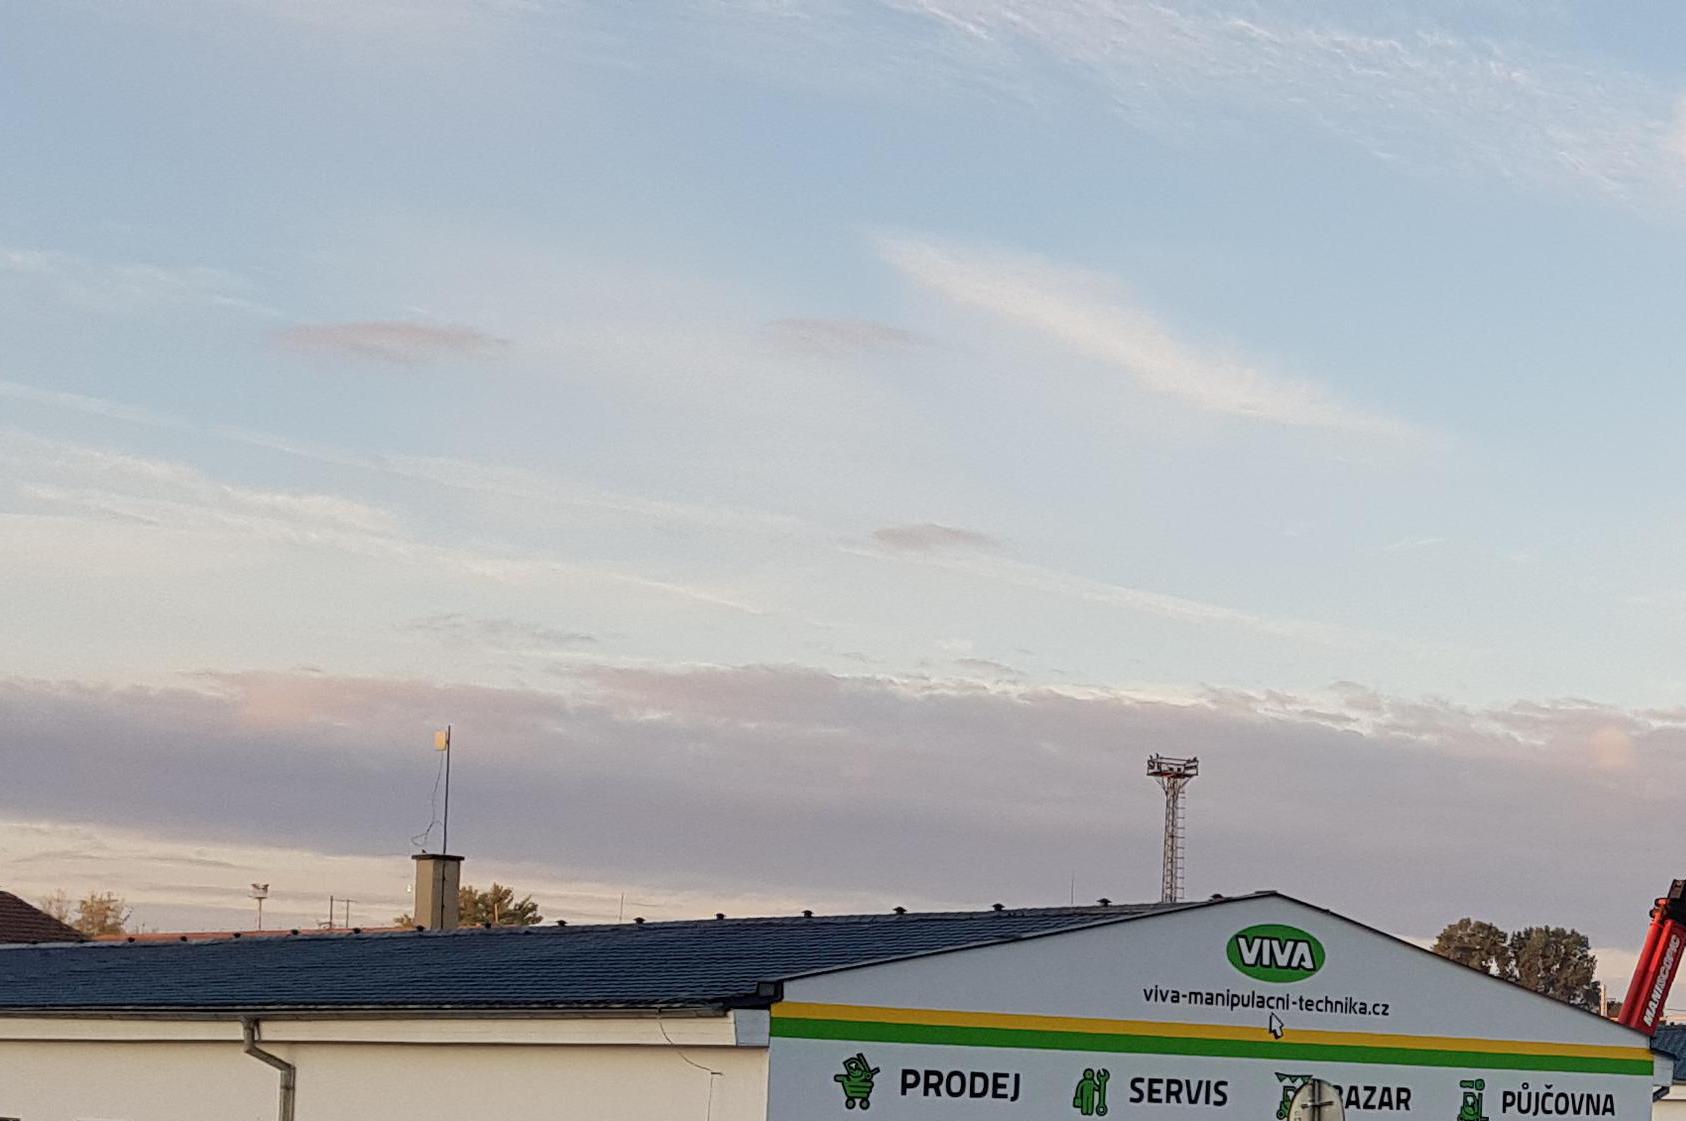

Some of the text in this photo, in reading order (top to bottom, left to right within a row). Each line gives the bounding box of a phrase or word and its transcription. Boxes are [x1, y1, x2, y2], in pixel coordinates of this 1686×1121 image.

[1236, 935, 1316, 971] VIVA
[1143, 985, 1390, 1016] viva-manipulacni-technika.cz
[900, 1068, 1020, 1102] PRODEJ
[1129, 1076, 1229, 1107] SERVIS
[1332, 1084, 1412, 1111] AZAR
[1502, 1082, 1616, 1117] PŮJČOVNA
